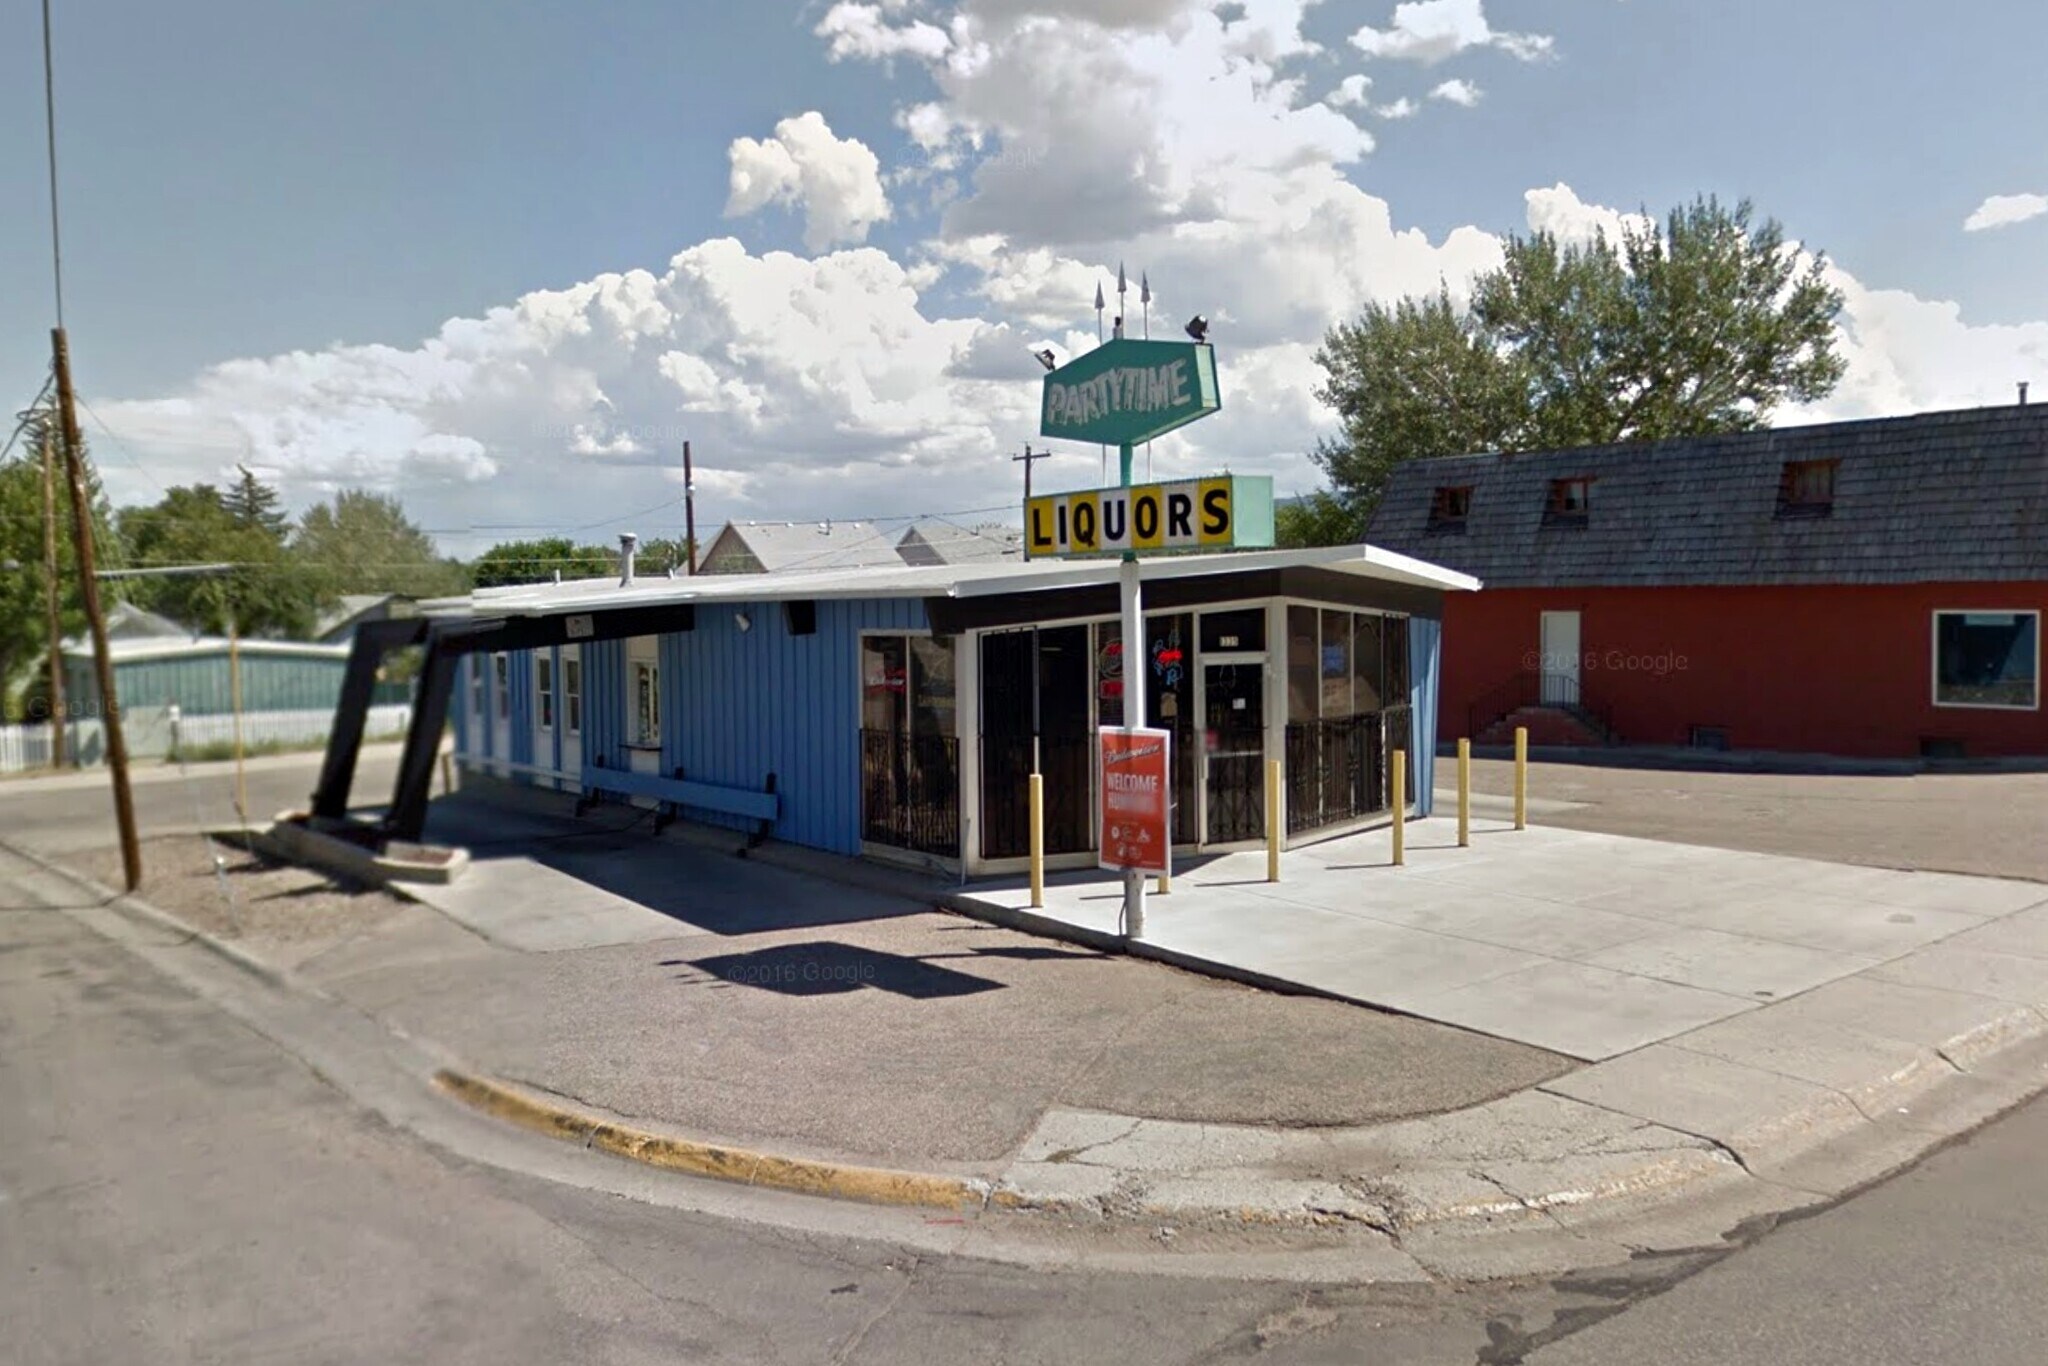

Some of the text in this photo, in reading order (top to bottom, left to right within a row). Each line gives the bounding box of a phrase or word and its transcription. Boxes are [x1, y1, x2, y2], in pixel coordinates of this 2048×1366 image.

[1048, 359, 1190, 425] PARTYTIME
[1033, 489, 1229, 546] LIQUORS
[1107, 772, 1158, 792] WELCOME
